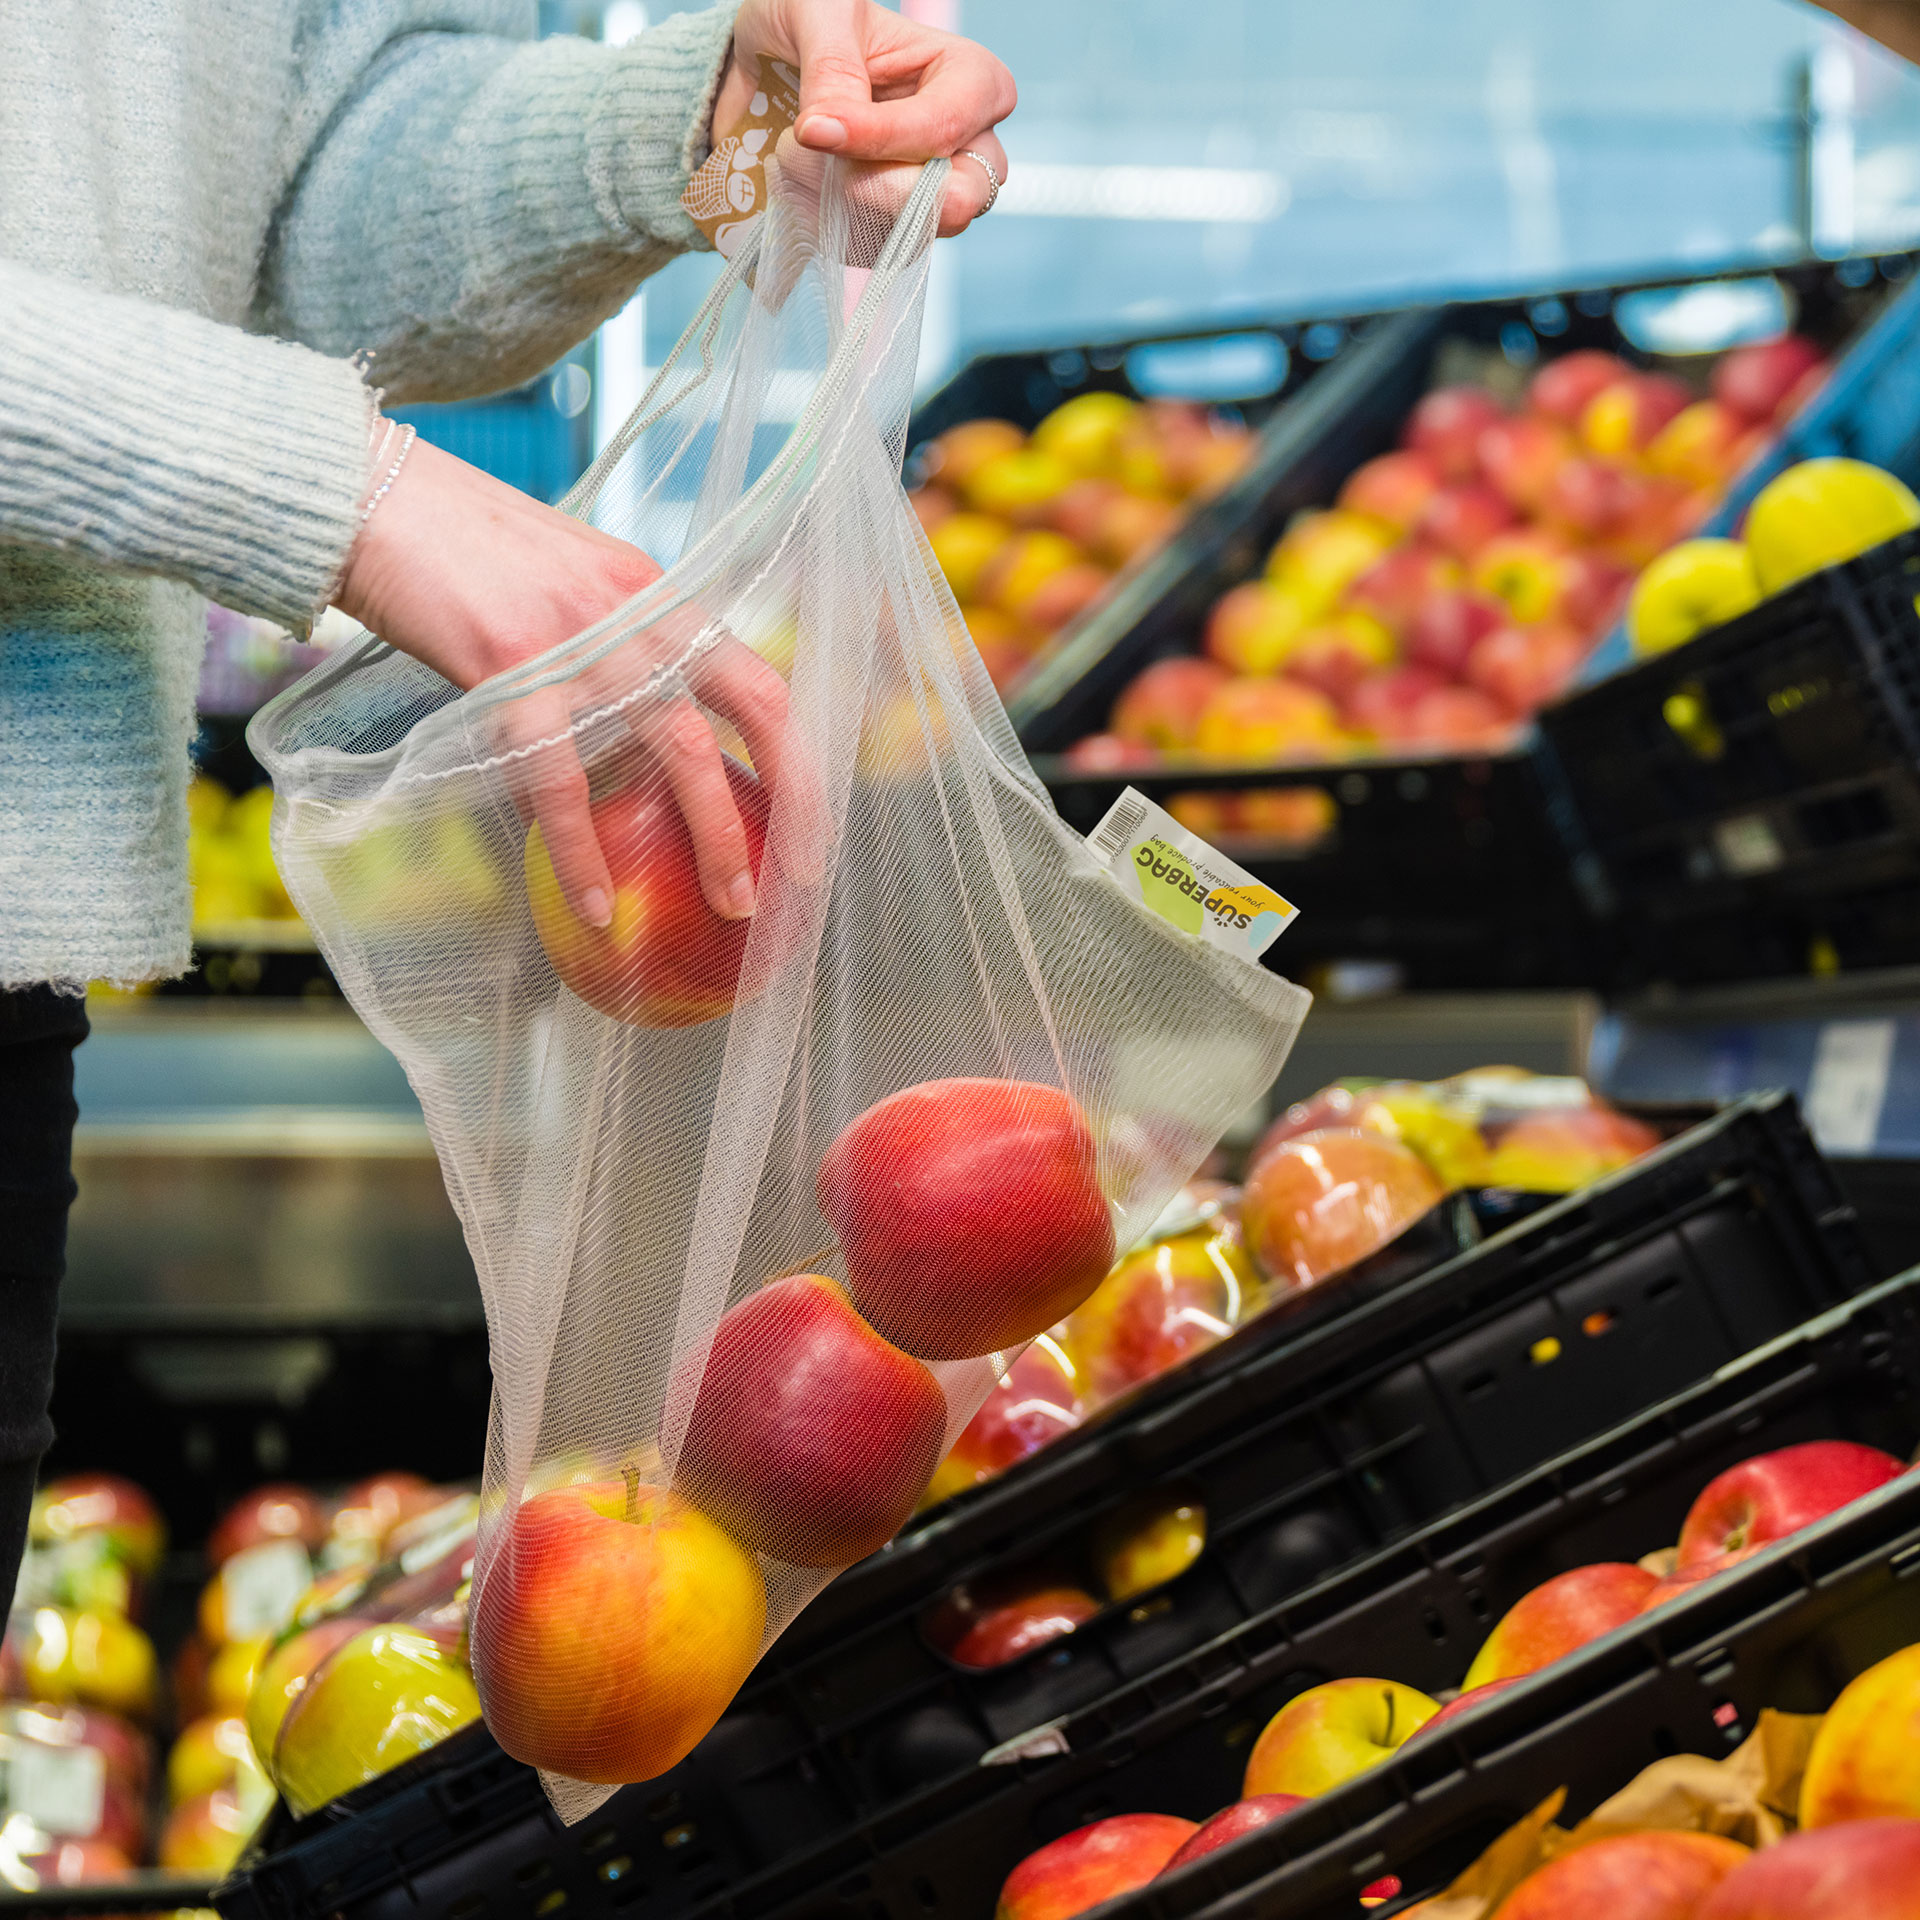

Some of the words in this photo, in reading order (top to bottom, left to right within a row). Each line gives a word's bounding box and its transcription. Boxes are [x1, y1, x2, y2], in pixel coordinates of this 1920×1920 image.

[1150, 833, 1167, 852] bag
[1167, 848, 1206, 871] produce
[1202, 870, 1240, 895] reusable
[1240, 895, 1265, 909] your
